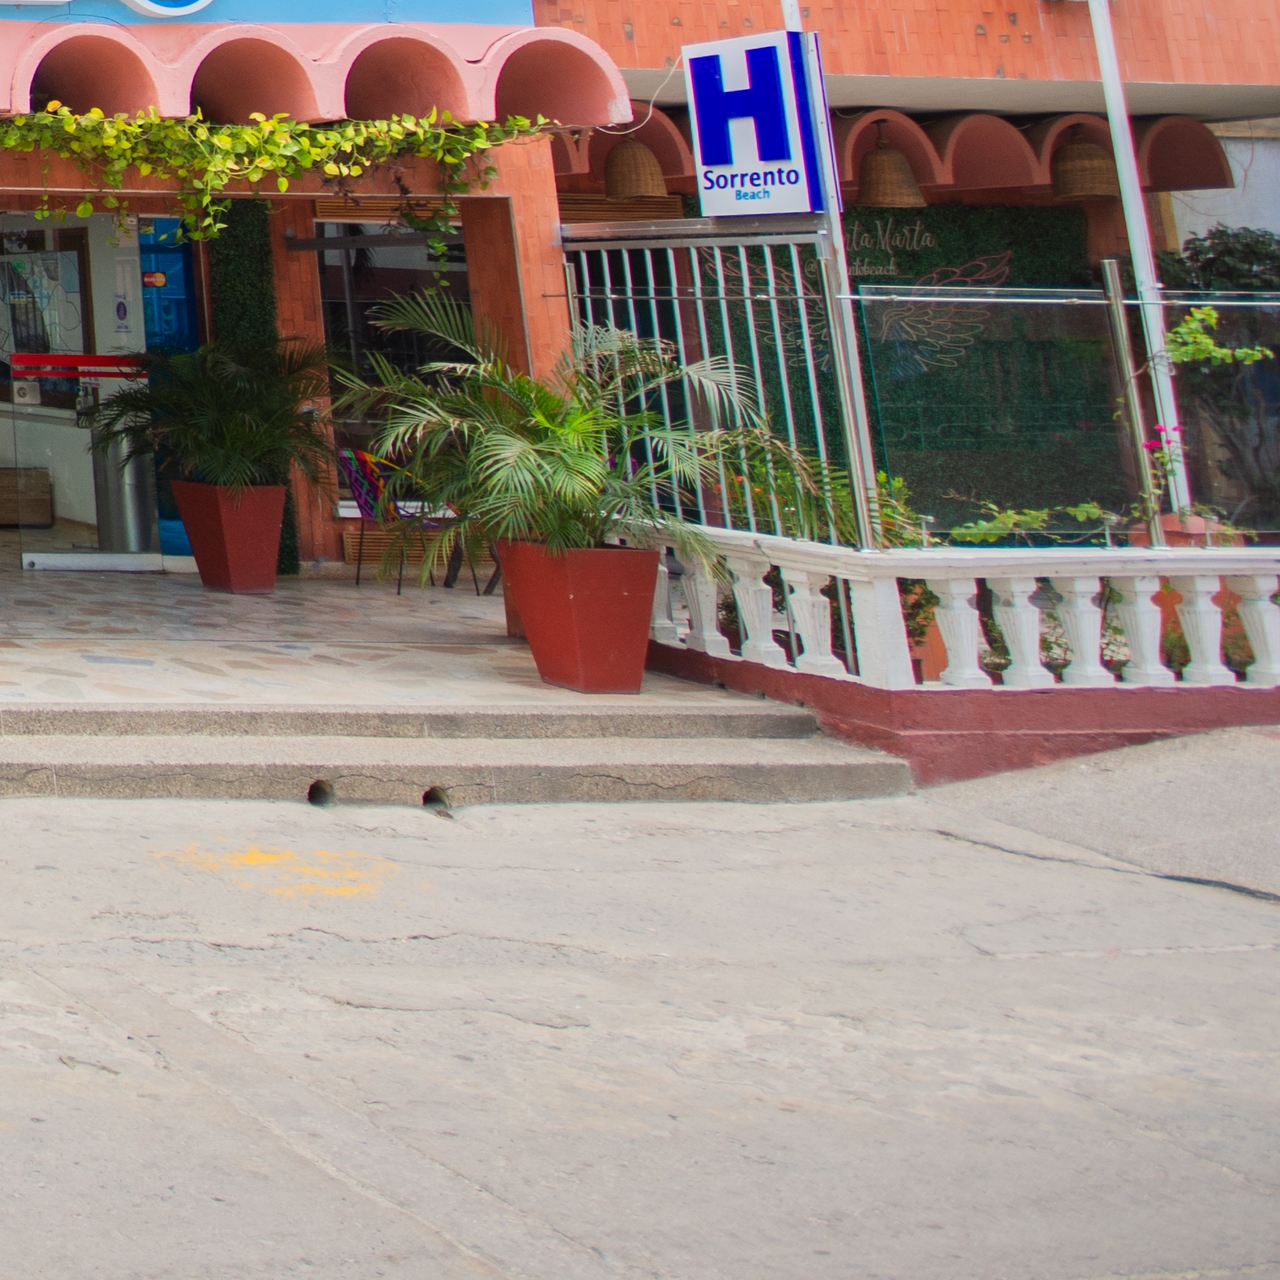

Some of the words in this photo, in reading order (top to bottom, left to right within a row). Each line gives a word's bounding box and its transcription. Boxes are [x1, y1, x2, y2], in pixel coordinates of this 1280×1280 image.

[688, 45, 792, 167] H
[703, 167, 801, 190] Sorrento
[735, 188, 771, 201] Beach
[875, 218, 935, 254] Marta
